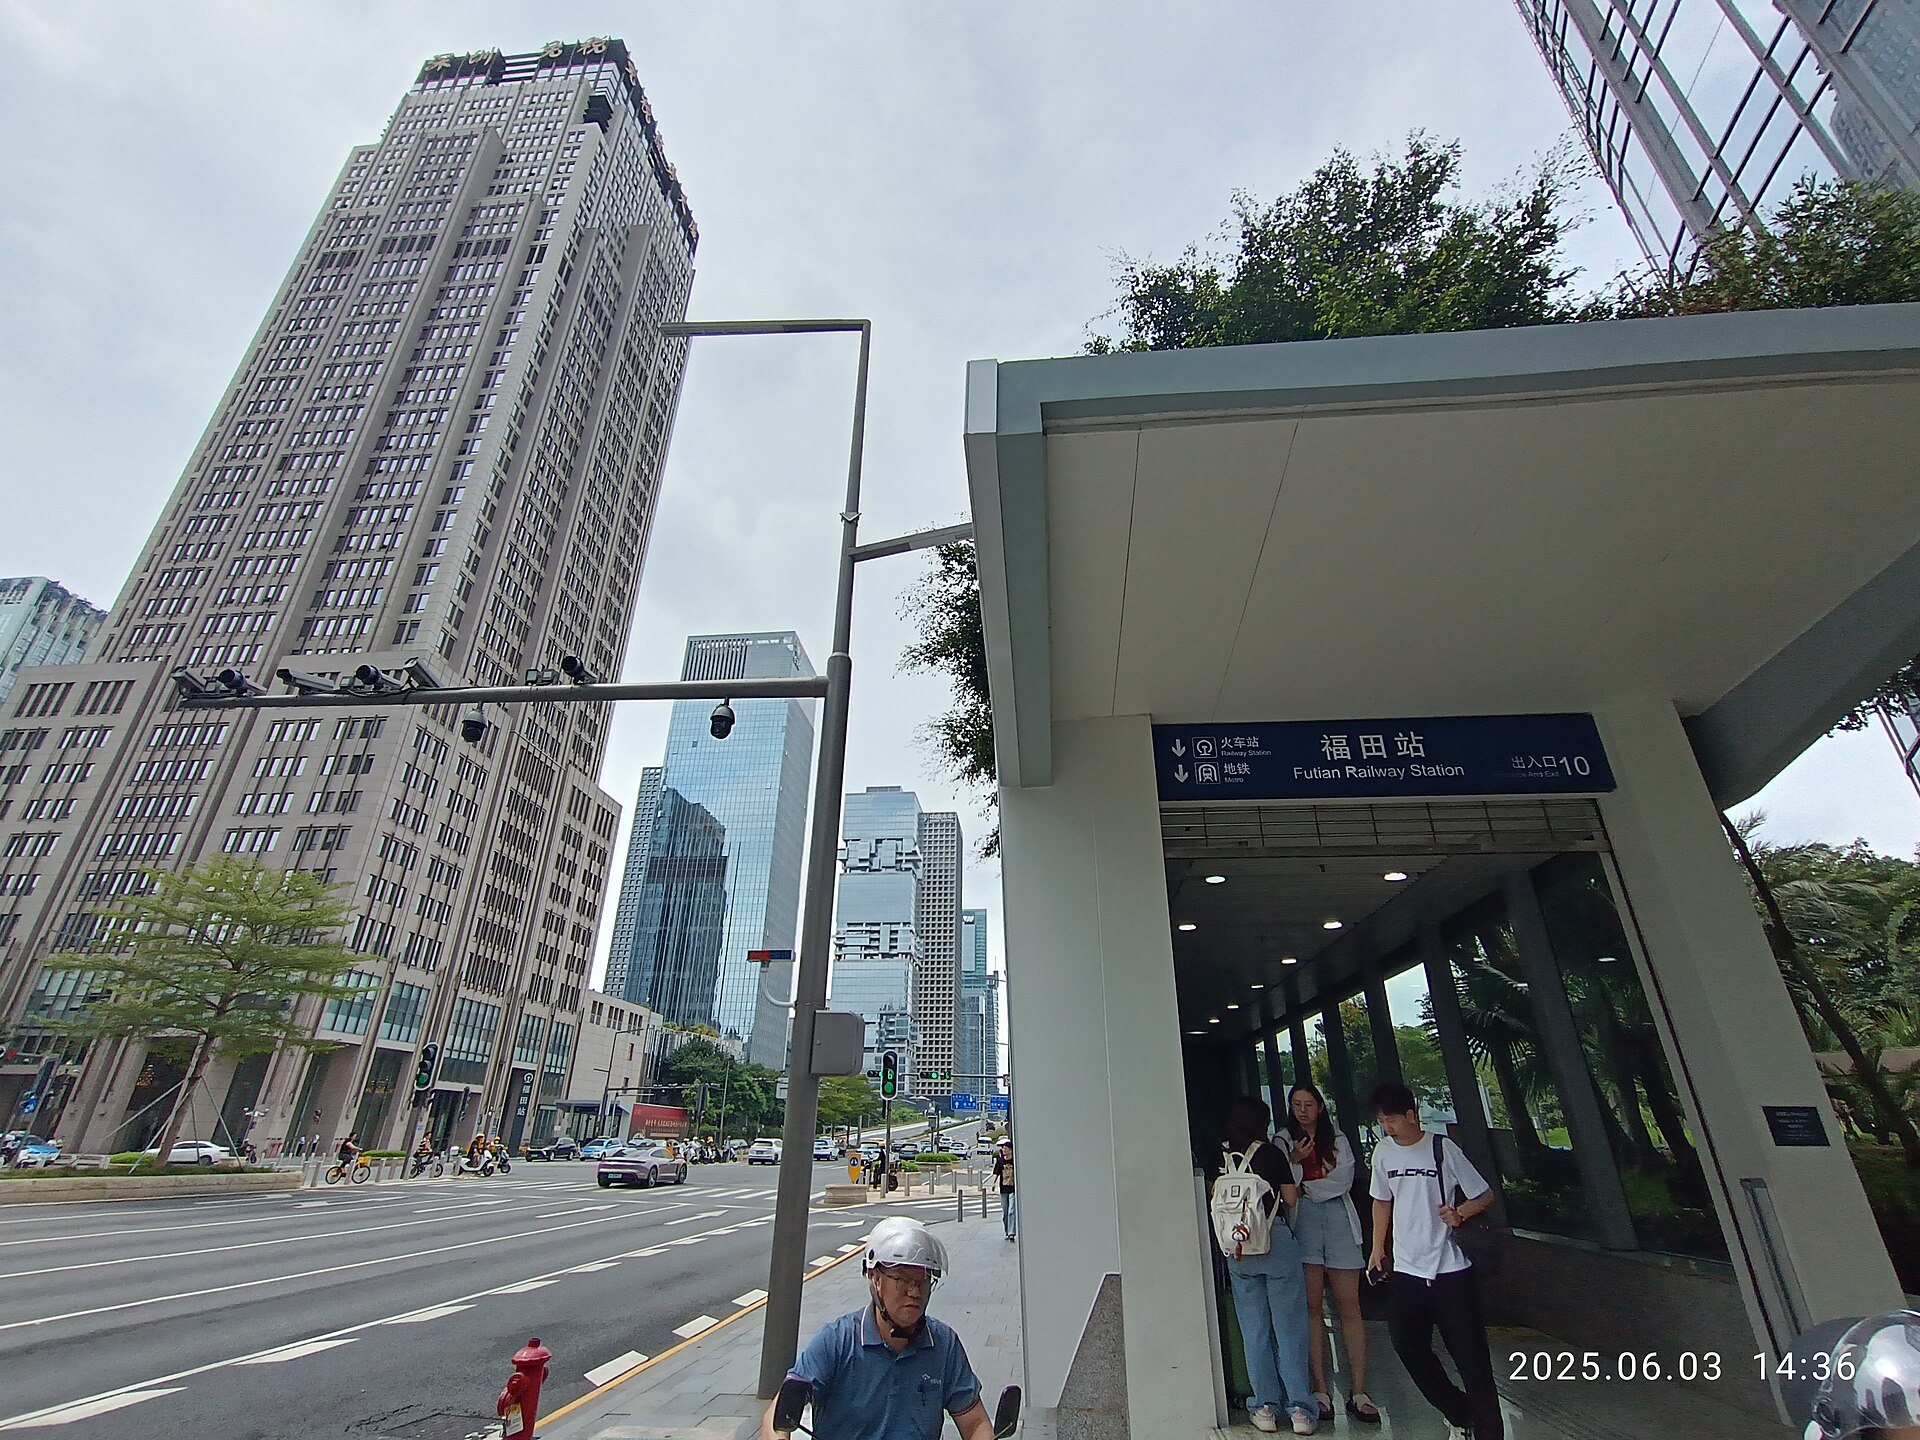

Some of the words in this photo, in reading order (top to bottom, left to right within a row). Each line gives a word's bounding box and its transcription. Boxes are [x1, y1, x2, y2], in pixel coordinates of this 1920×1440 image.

[1221, 736, 1259, 749] 火车站
[1320, 731, 1426, 761] 福田站
[1223, 763, 1251, 775] 地铁
[1293, 766, 1341, 780] Futian
[1345, 765, 1406, 780] Railway
[1410, 764, 1465, 777] Station
[1511, 755, 1557, 769] 出入口
[1559, 756, 1591, 776] 10
